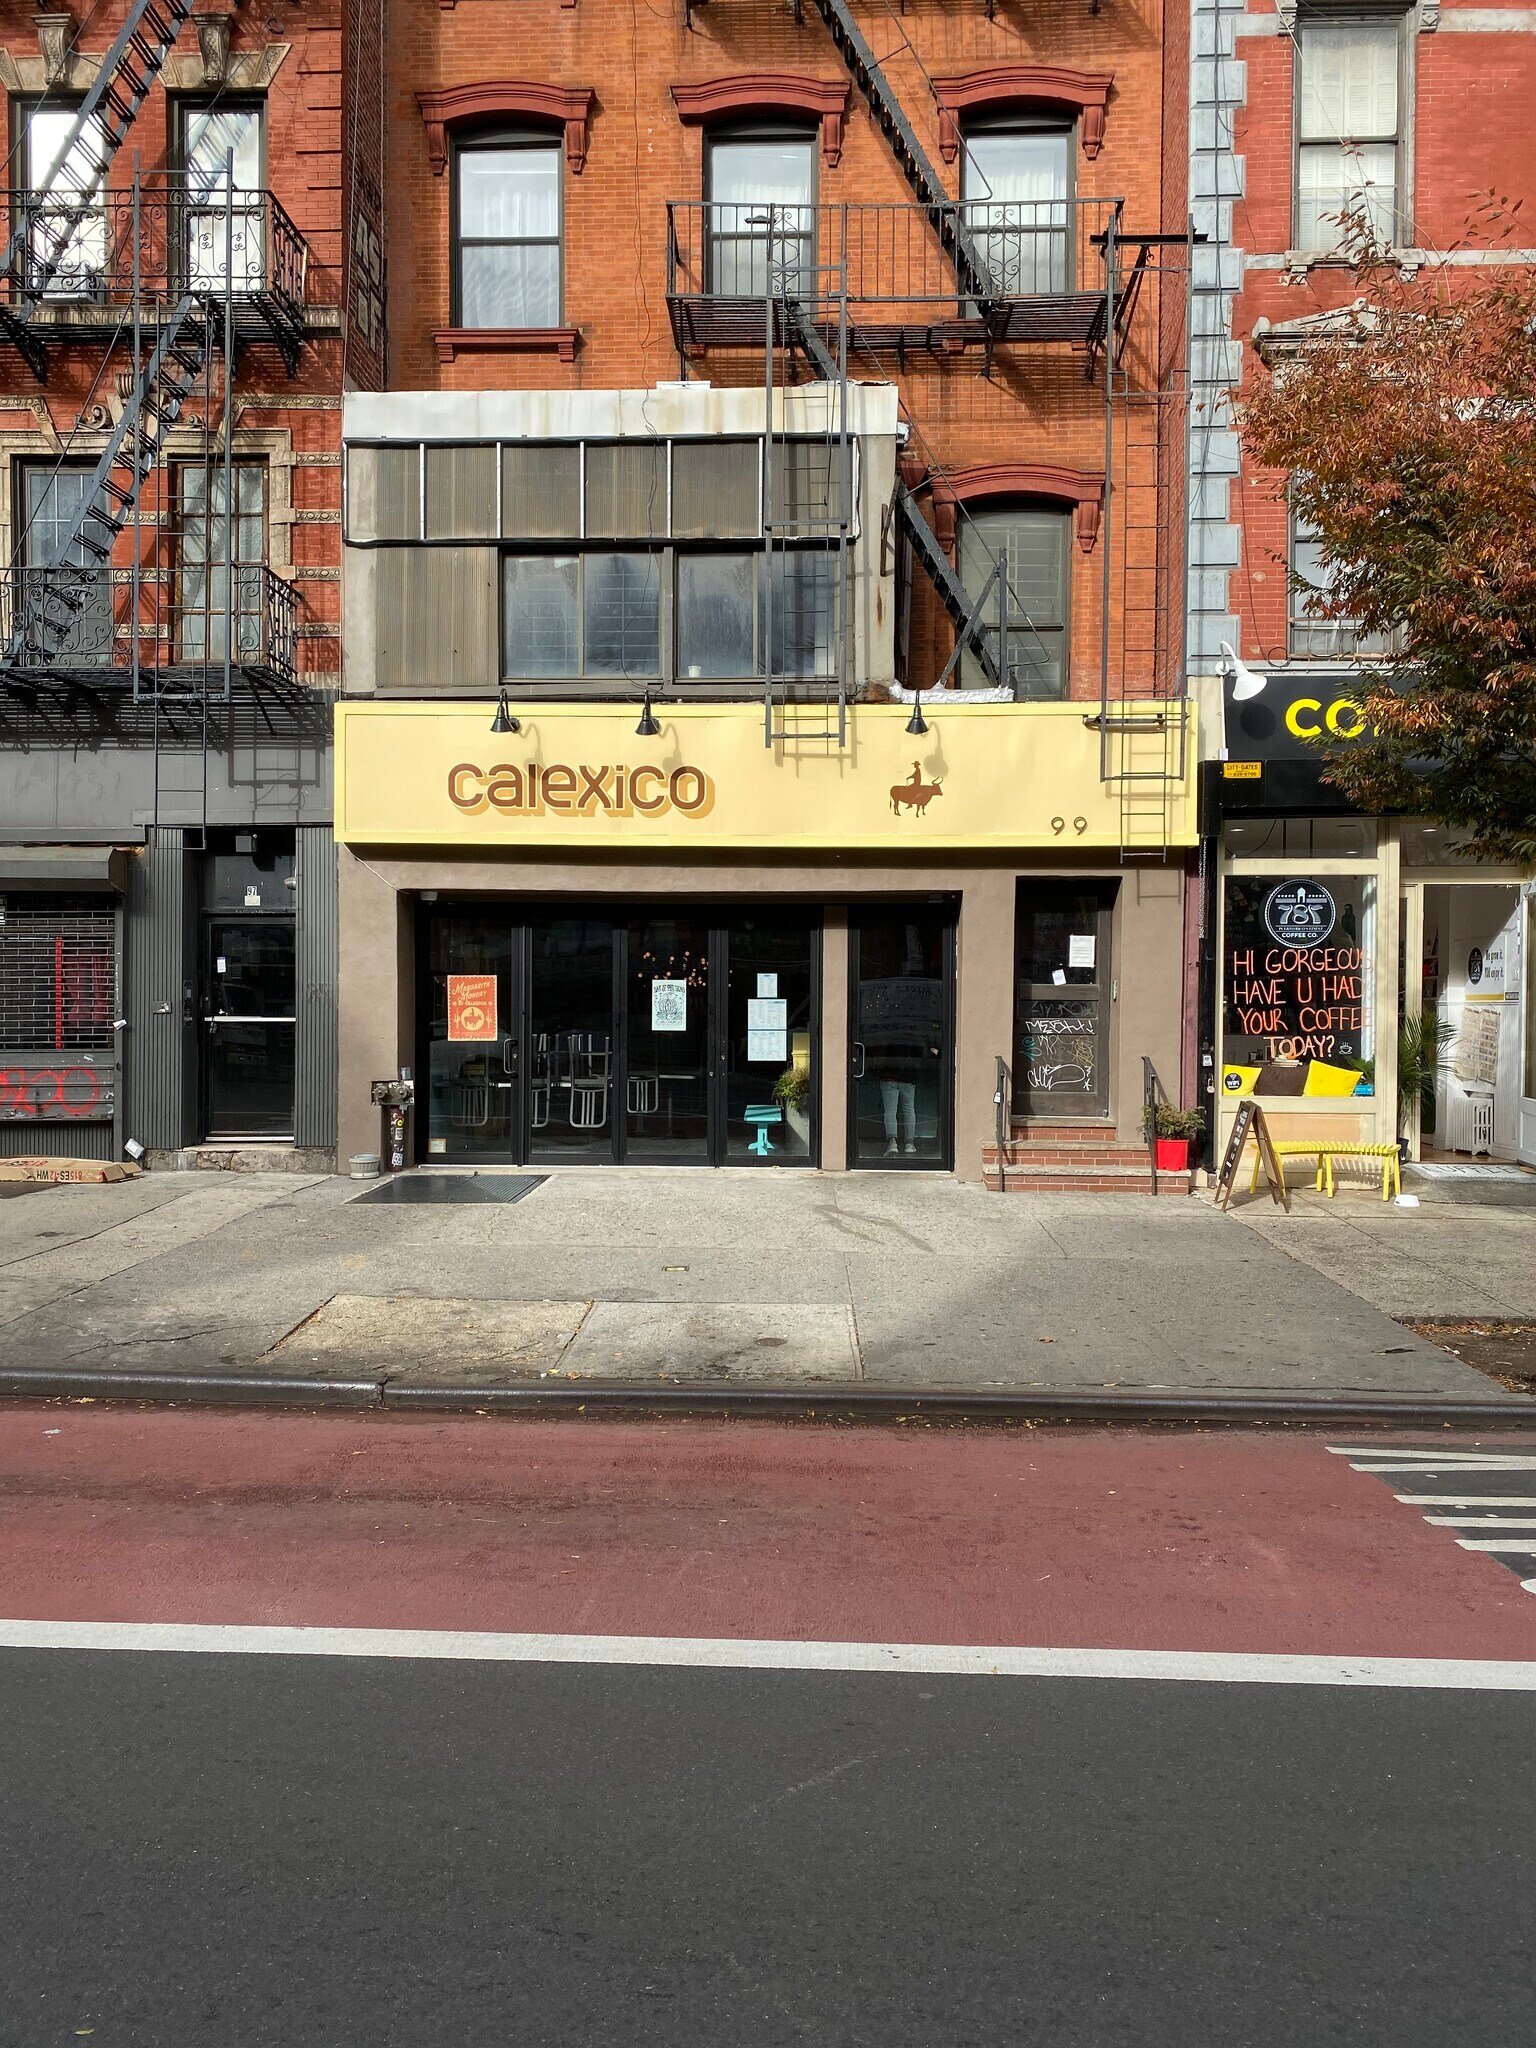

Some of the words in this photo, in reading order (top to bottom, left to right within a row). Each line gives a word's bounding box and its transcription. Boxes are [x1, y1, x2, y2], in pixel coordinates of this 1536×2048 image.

[448, 763, 714, 818] calexico
[1051, 816, 1087, 836] 99
[247, 886, 257, 896] 97
[1277, 904, 1324, 925] 787
[1233, 949, 1254, 976] HI
[1233, 979, 1287, 1005] HAVE
[1297, 977, 1313, 1004] U
[1321, 975, 1366, 1001] HAD
[1237, 1007, 1289, 1034] YOUR
[1299, 1006, 1374, 1032] COFFEE
[1263, 1035, 1335, 1060] TODAY?
